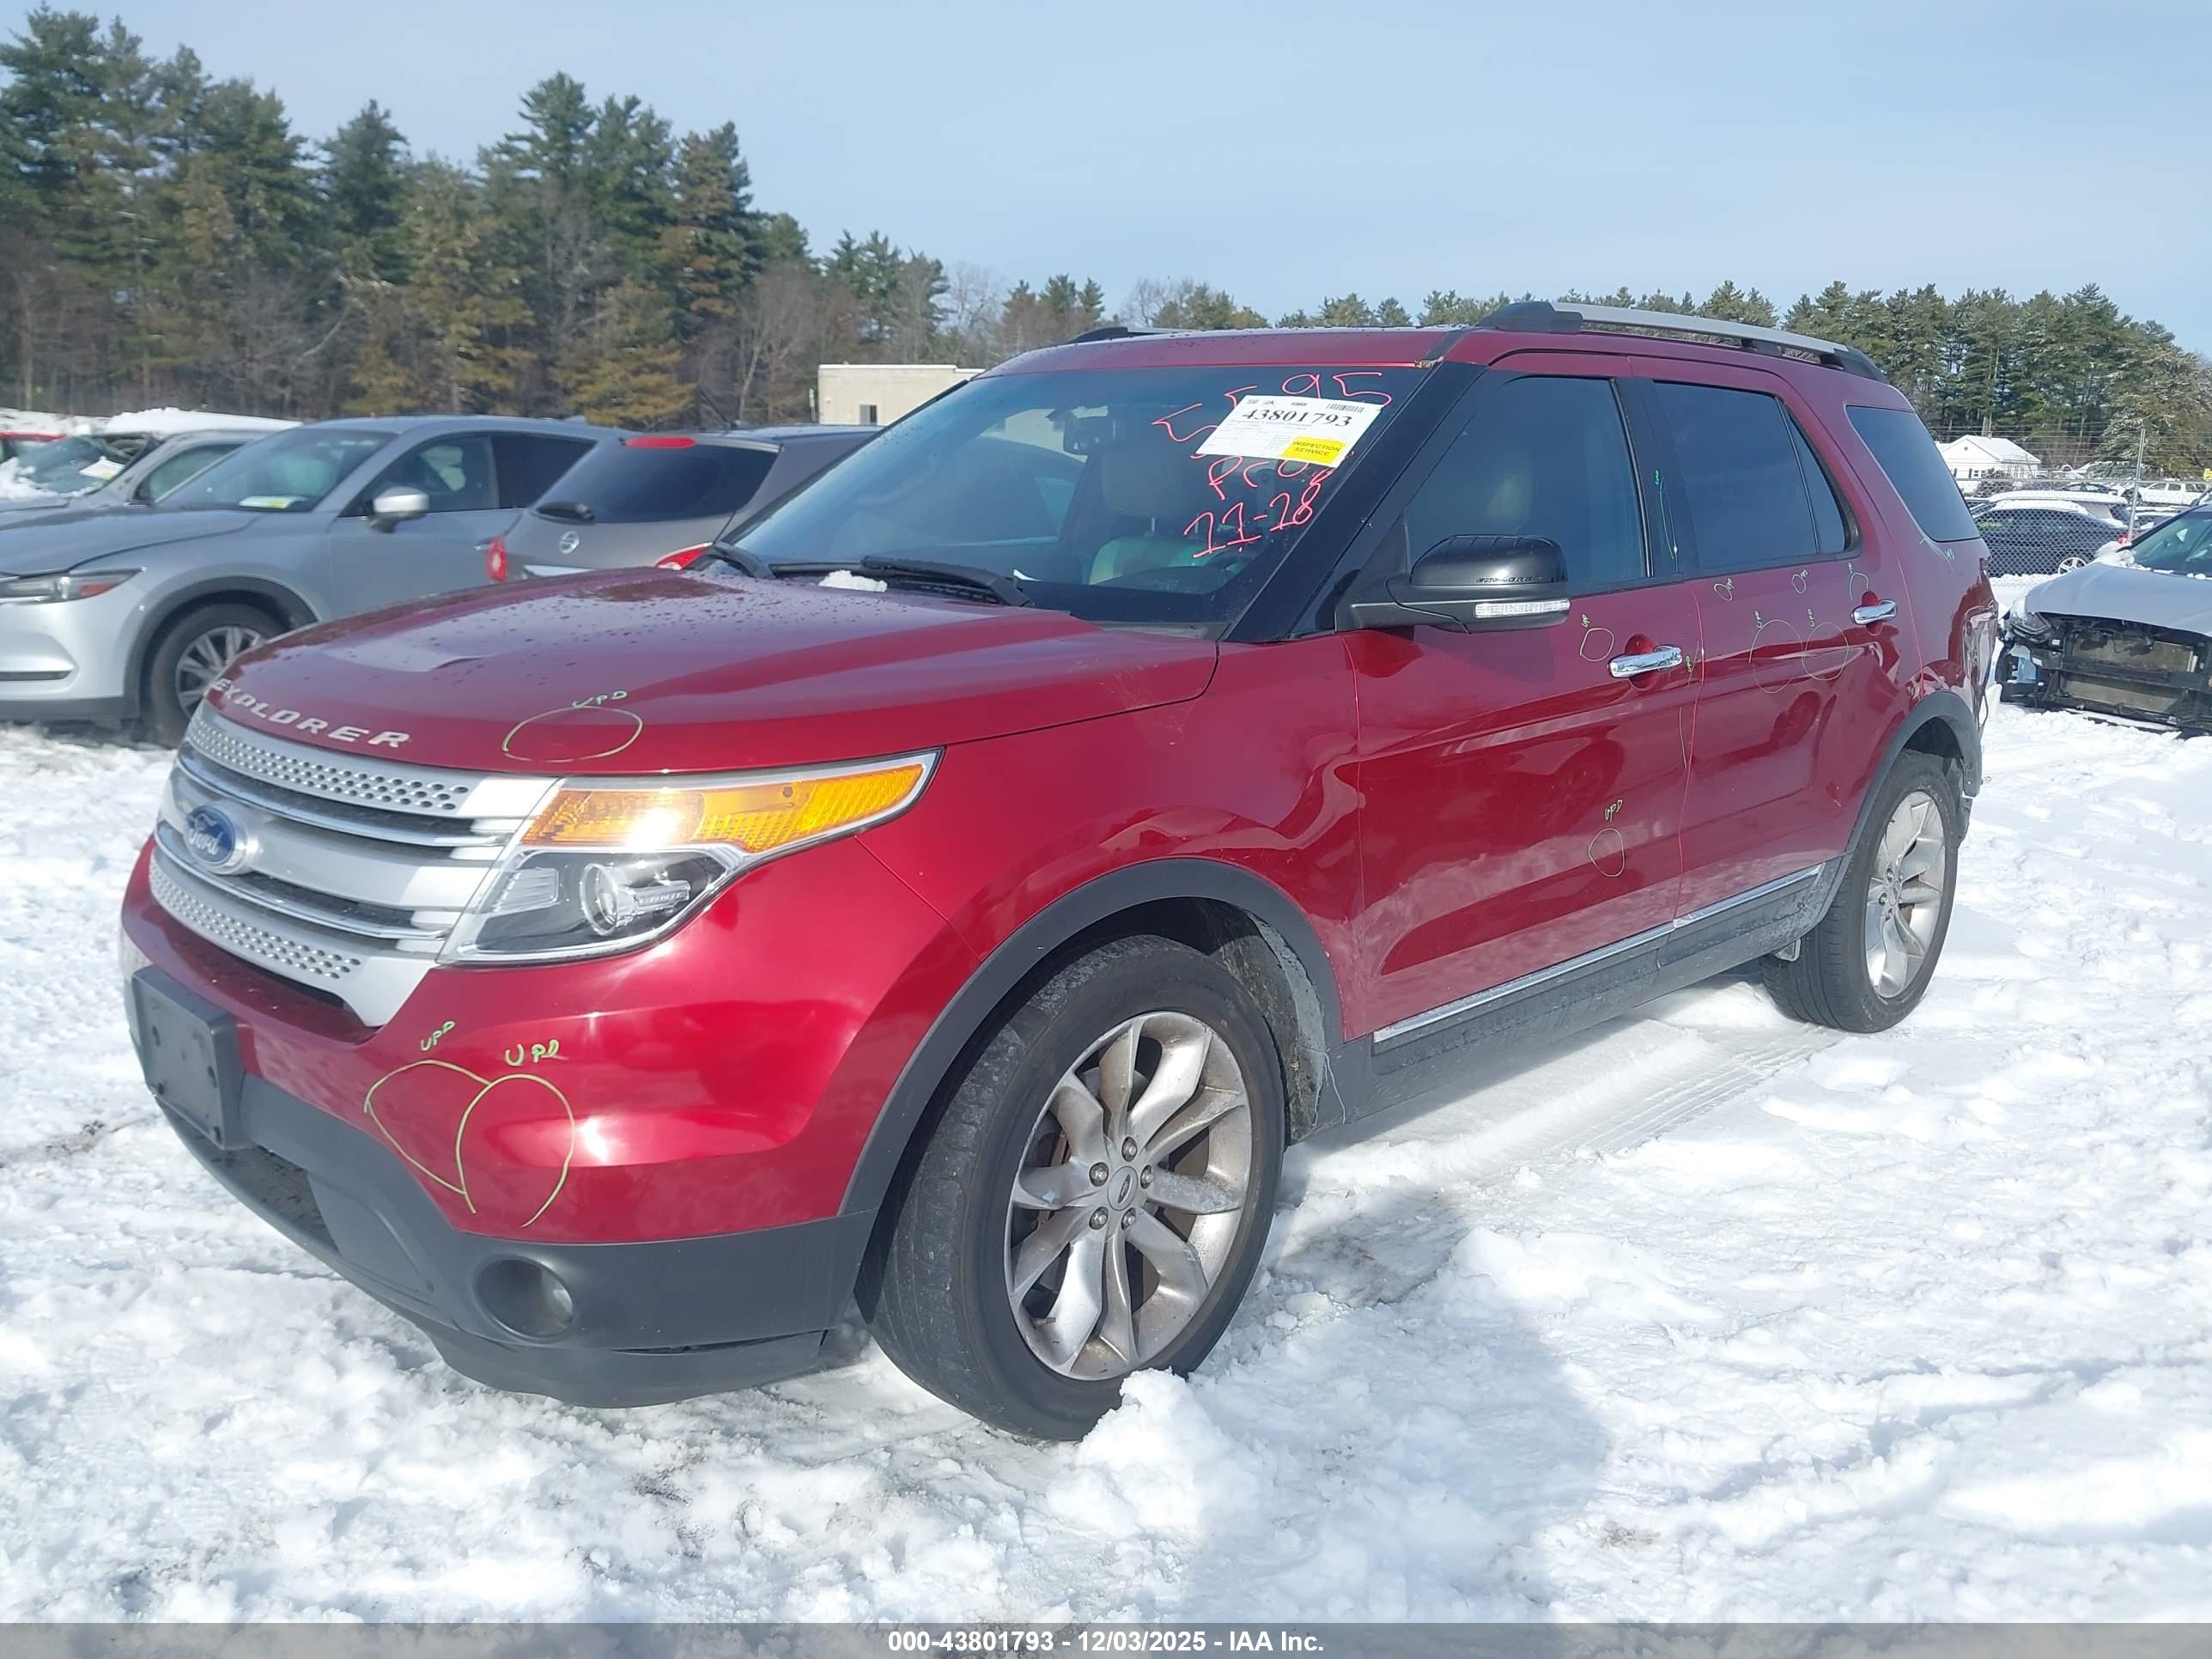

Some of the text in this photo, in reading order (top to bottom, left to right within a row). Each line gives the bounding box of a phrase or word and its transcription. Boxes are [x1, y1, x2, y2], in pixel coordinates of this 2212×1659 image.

[1243, 408, 1352, 427] 43801793
[1292, 441, 1340, 453] INSPECTION
[1294, 447, 1331, 456] SERVICE
[212, 677, 410, 748] EXPLORER
[188, 812, 224, 856] Ford
